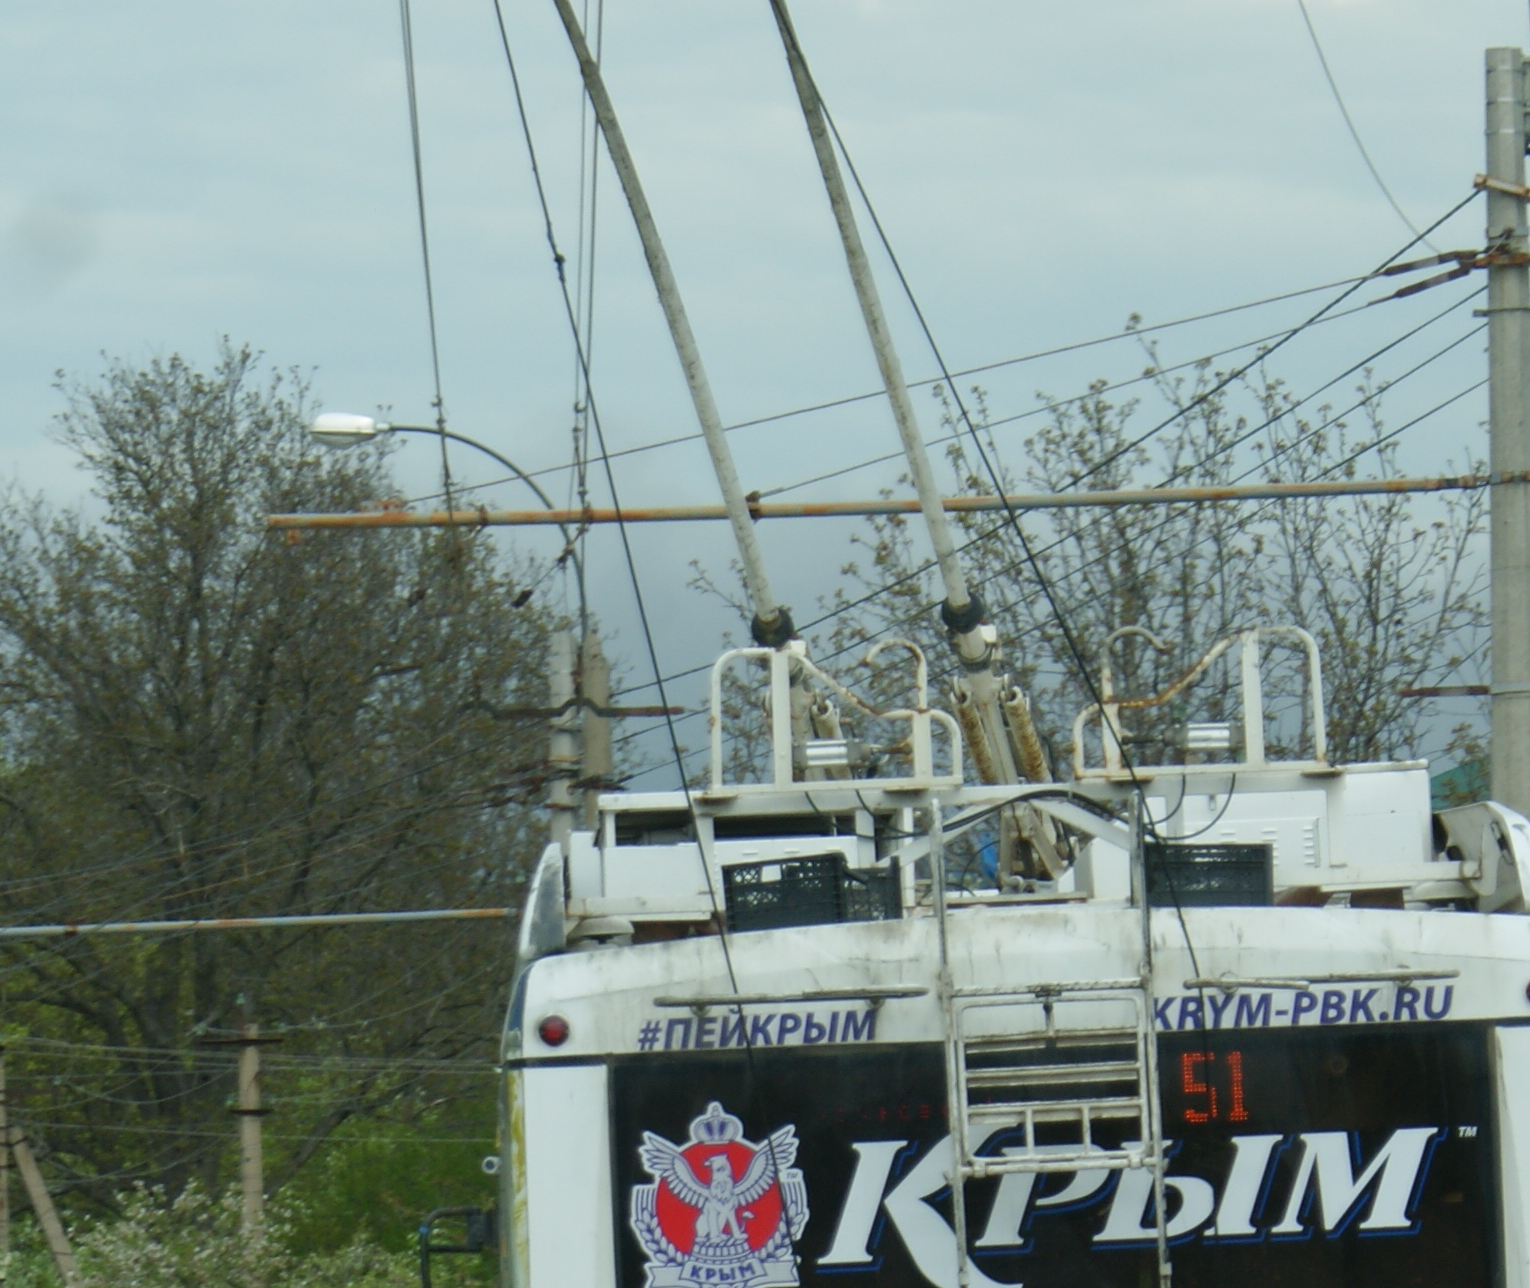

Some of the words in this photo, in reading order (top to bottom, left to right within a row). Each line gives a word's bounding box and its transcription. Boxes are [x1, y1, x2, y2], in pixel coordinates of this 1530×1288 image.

[637, 1007, 877, 1051] #ПЕЙКРЫМ
[1154, 984, 1454, 1032] KRYM-PBK.RU
[1182, 1051, 1248, 1122] 51
[690, 1262, 756, 1281] КРЫМ
